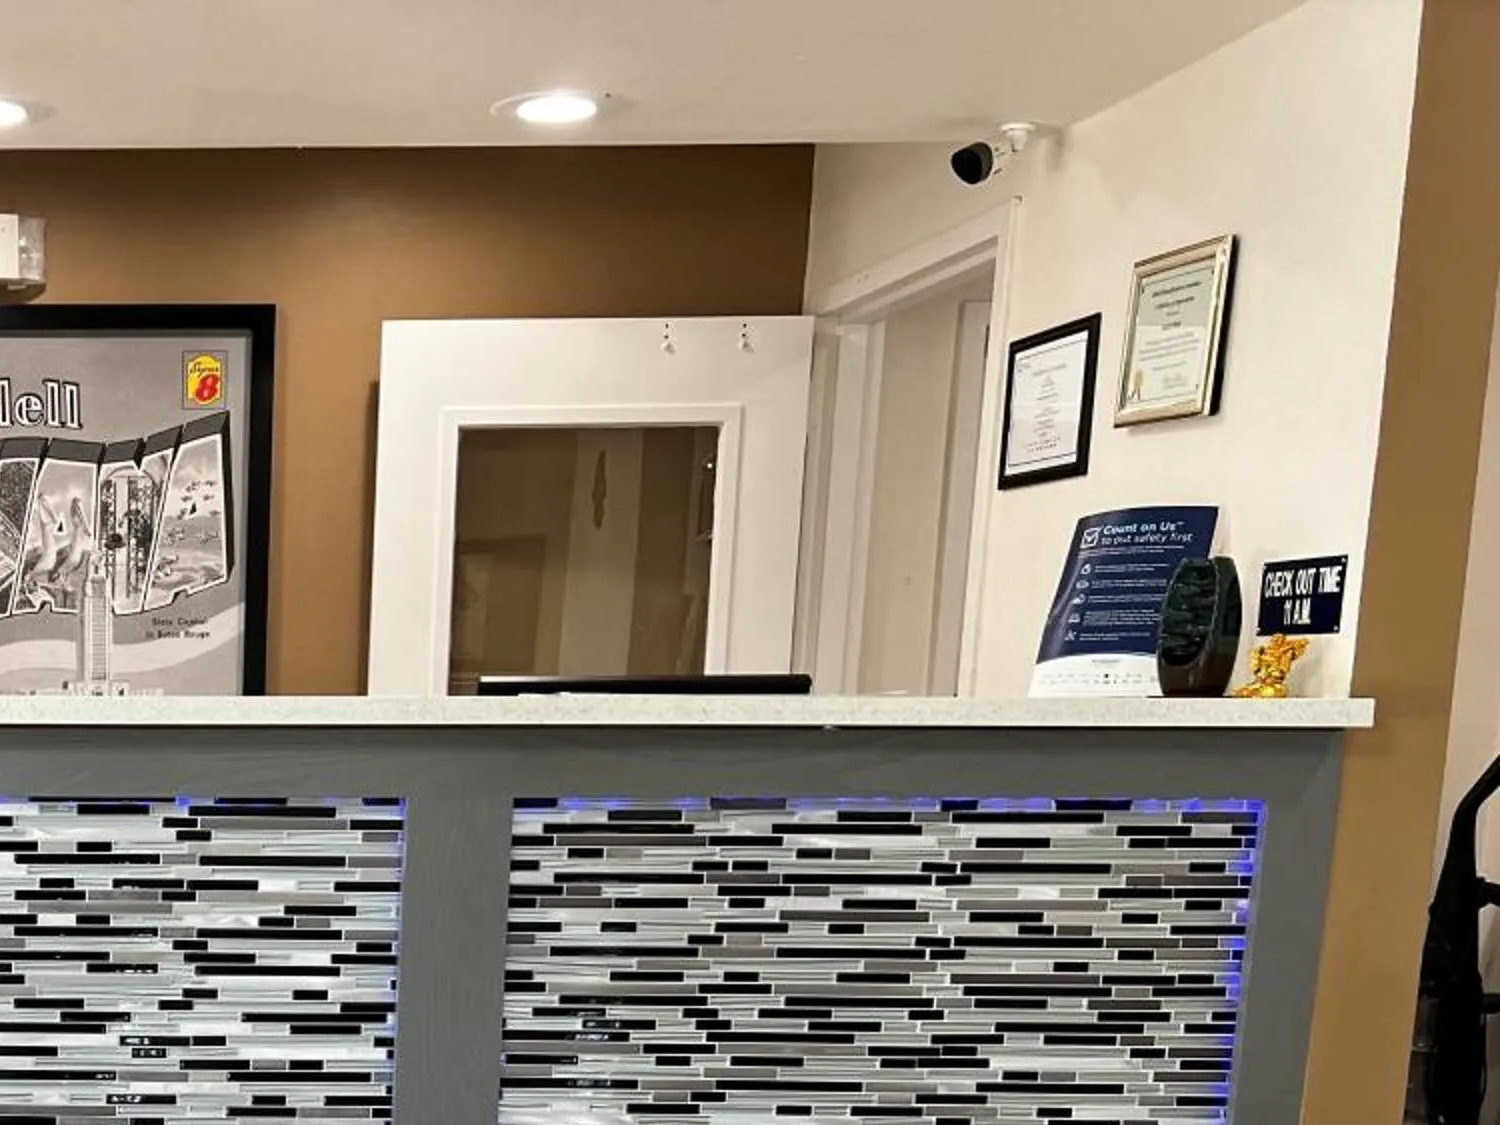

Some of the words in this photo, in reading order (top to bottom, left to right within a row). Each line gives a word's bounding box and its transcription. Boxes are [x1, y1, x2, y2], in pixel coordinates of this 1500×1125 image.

[195, 374, 219, 402] 8
[1102, 523, 1137, 535] Count
[1140, 522, 1158, 532] on
[1134, 532, 1167, 543] safety
[1168, 532, 1193, 542] first
[1264, 570, 1294, 598] CHECK
[1296, 569, 1316, 595] OUT
[1318, 566, 1342, 592] TIME
